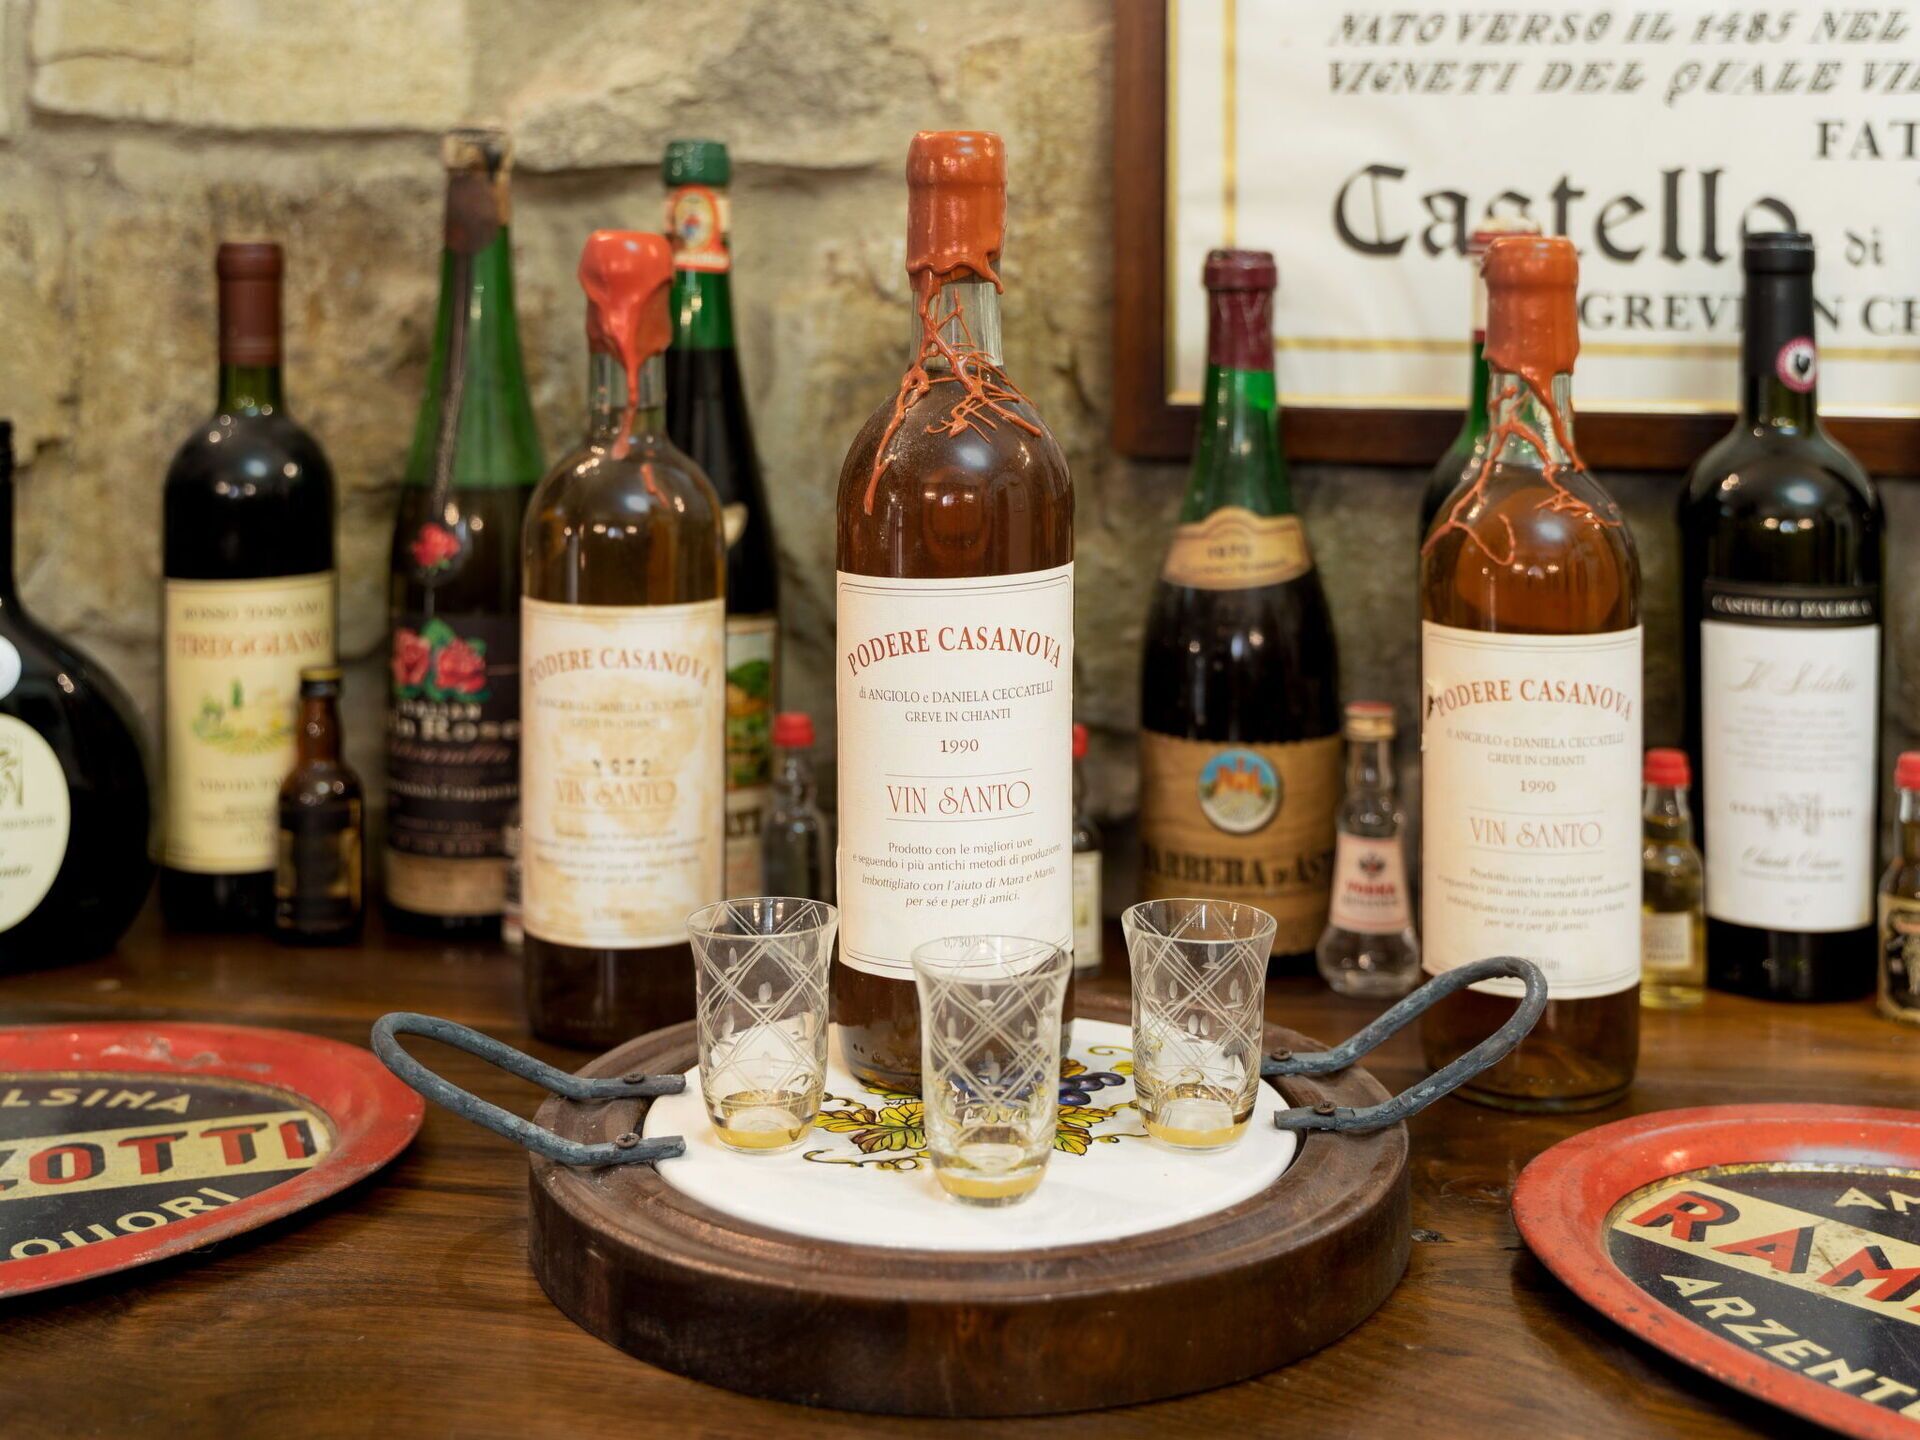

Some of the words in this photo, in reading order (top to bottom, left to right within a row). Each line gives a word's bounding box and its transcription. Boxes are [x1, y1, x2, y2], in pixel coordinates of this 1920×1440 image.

[1327, 12, 1446, 47] NATO
[1457, 12, 1612, 46] VERSO
[1623, 11, 1675, 44] IL
[1811, 11, 1908, 44] NEL
[1328, 61, 1523, 95] VIGNETI
[1534, 61, 1648, 95] DEL
[1663, 61, 1843, 108] QUALE
[1579, 292, 1744, 332] GREV
[848, 628, 930, 676] PODERE
[938, 626, 1061, 668] CASANOVA
[528, 648, 595, 688] PODERE
[600, 647, 711, 689] CASANOVA
[859, 685, 867, 699] di
[868, 689, 920, 703] ANGIOLO
[922, 694, 929, 703] e
[932, 690, 989, 704] DANIELA
[992, 680, 1054, 702] CECCATELLI
[1434, 679, 1512, 718] PODERE
[1519, 678, 1633, 721] CASANOVA
[905, 711, 942, 723] GREVE
[945, 711, 958, 722] IN
[961, 708, 1011, 722] CHIANTI
[940, 738, 979, 754] 1990
[1512, 735, 1565, 749] DANIELA
[886, 785, 927, 814] VIN
[938, 780, 1031, 815] SANTO
[1519, 779, 1557, 794] 1990
[888, 842, 932, 855] Prodotto
[935, 846, 956, 855] con
[960, 843, 970, 855] le
[973, 840, 1014, 855] migliori
[1016, 838, 1033, 849] uve
[1469, 817, 1507, 845] VIN
[1516, 821, 1602, 849] SANTO
[858, 855, 898, 868] seguendo
[907, 859, 924, 872] più
[928, 859, 966, 871] antichi
[969, 855, 1006, 870] metodi
[1009, 854, 1019, 865] di
[862, 873, 920, 891] Imbottigliato
[923, 882, 943, 891] con
[947, 879, 982, 891] l'aiuto
[985, 877, 996, 889] di
[999, 876, 1024, 887] Mara
[1026, 874, 1032, 882] e
[905, 896, 923, 908] per
[926, 896, 938, 907] sé
[941, 898, 947, 907] e
[950, 896, 969, 909] per
[971, 894, 986, 908] gli
[989, 890, 1020, 904] amici.
[0, 1118, 318, 1192] OTTI
[1626, 1190, 1920, 1314] RAM
